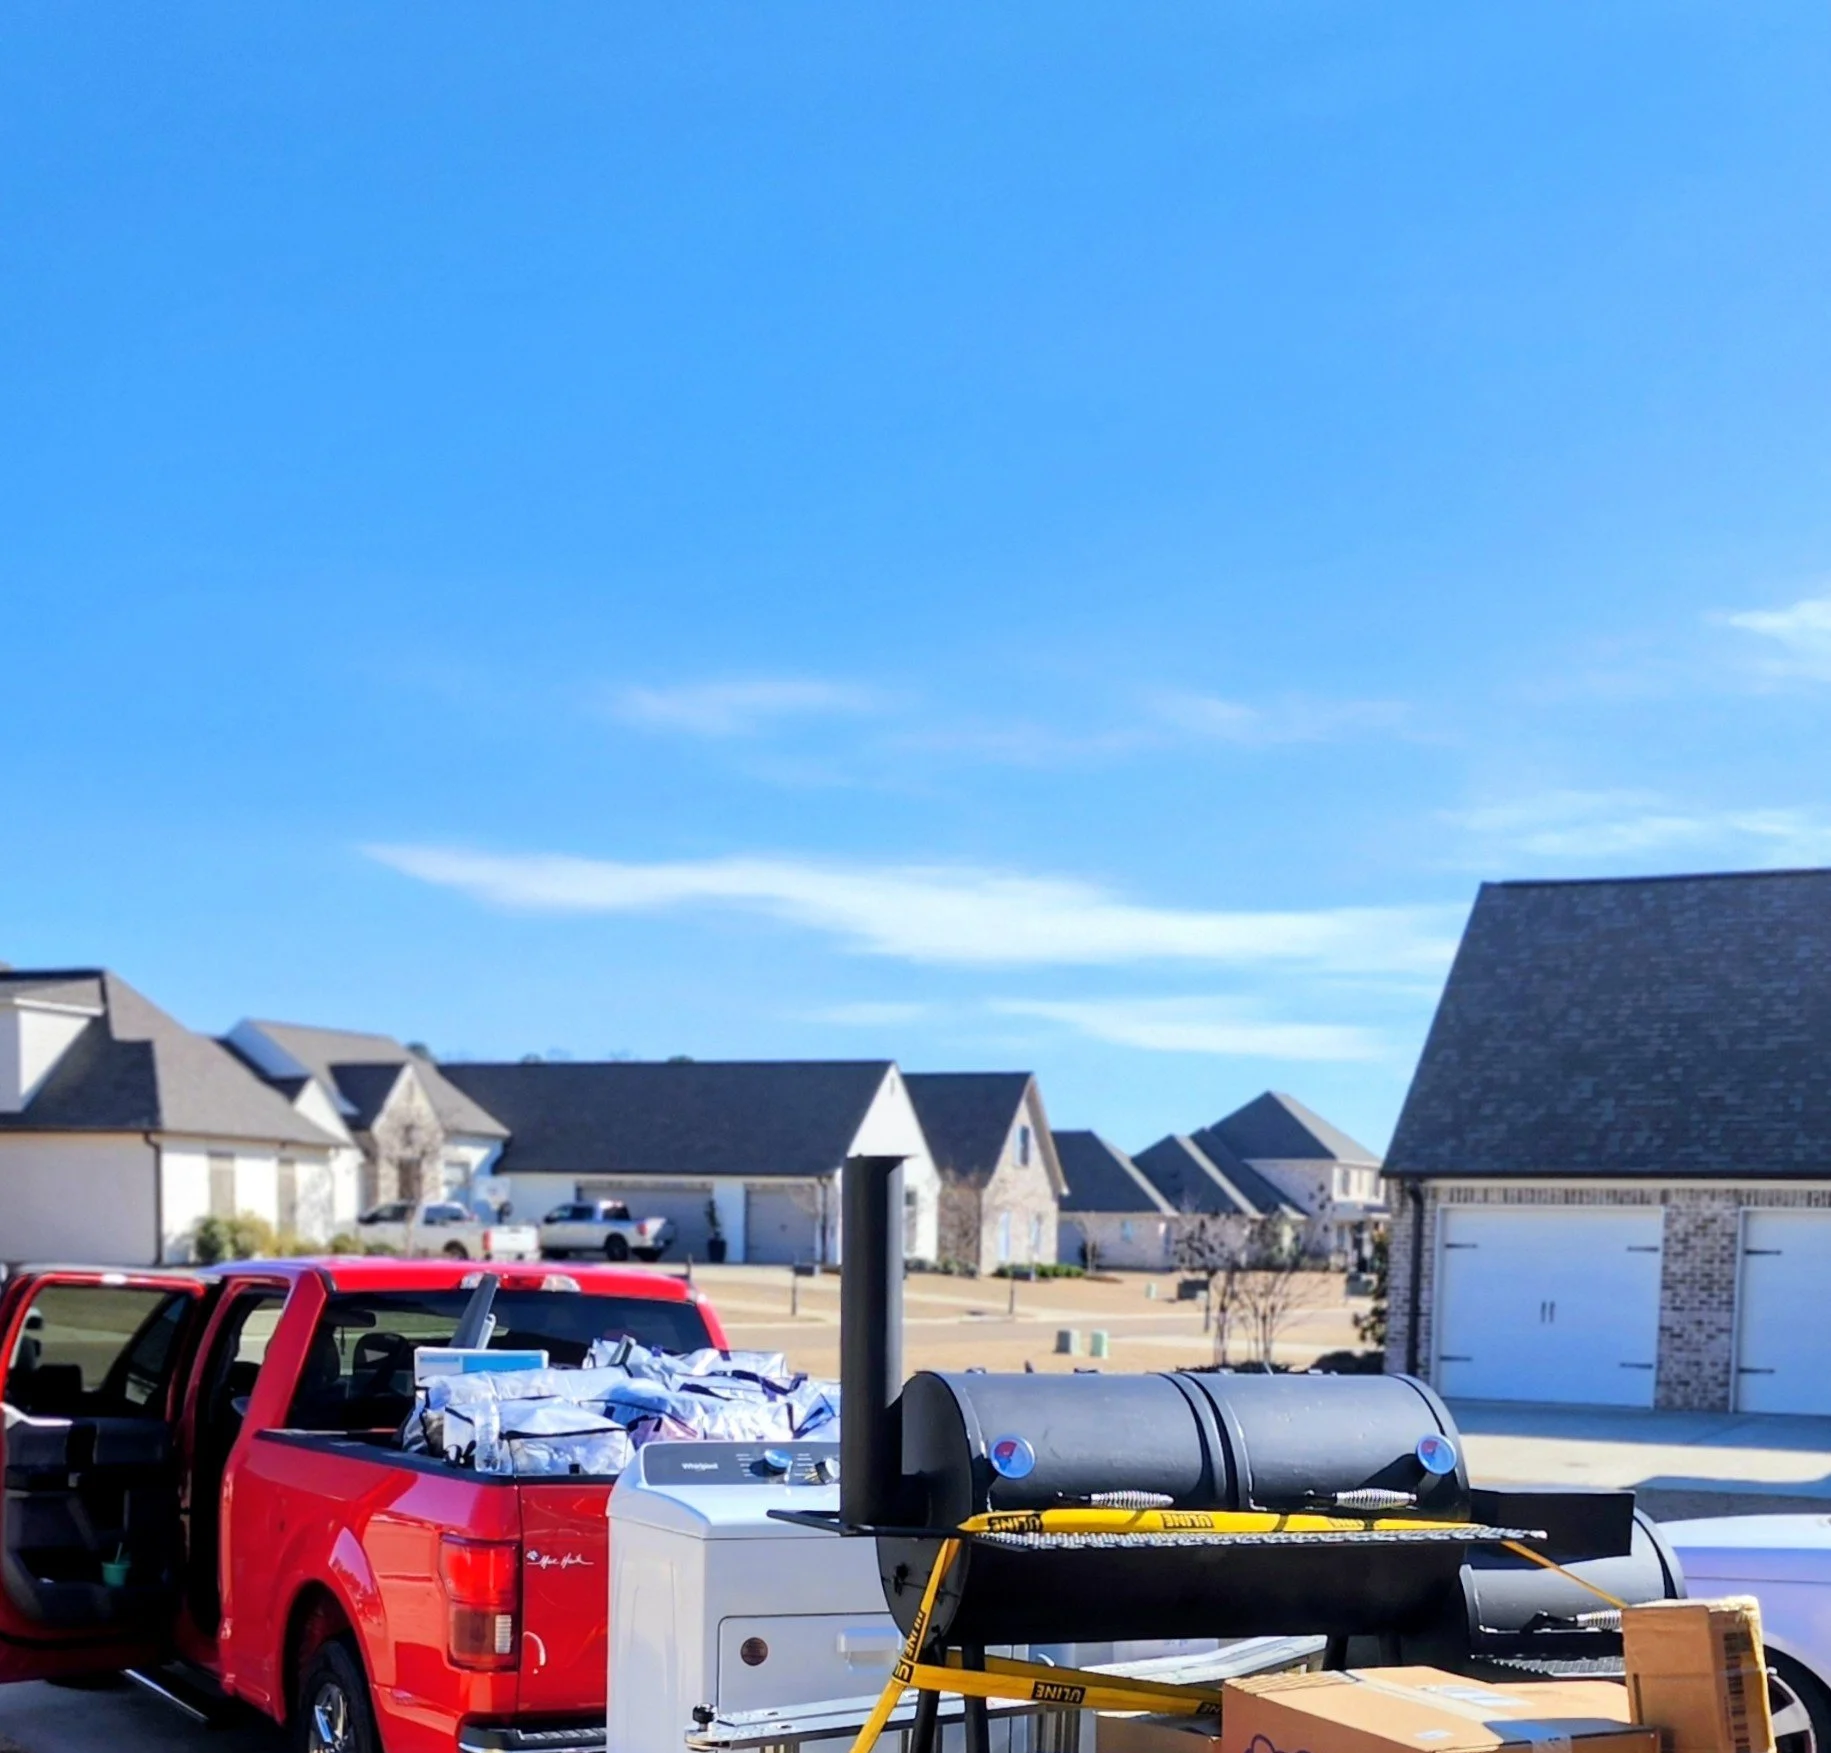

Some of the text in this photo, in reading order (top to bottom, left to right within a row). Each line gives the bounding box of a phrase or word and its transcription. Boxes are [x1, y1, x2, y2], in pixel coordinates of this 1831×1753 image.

[989, 1514, 1042, 1533] ULINE
[1163, 1513, 1213, 1529] ULINE
[1035, 1684, 1082, 1700] ULINE
